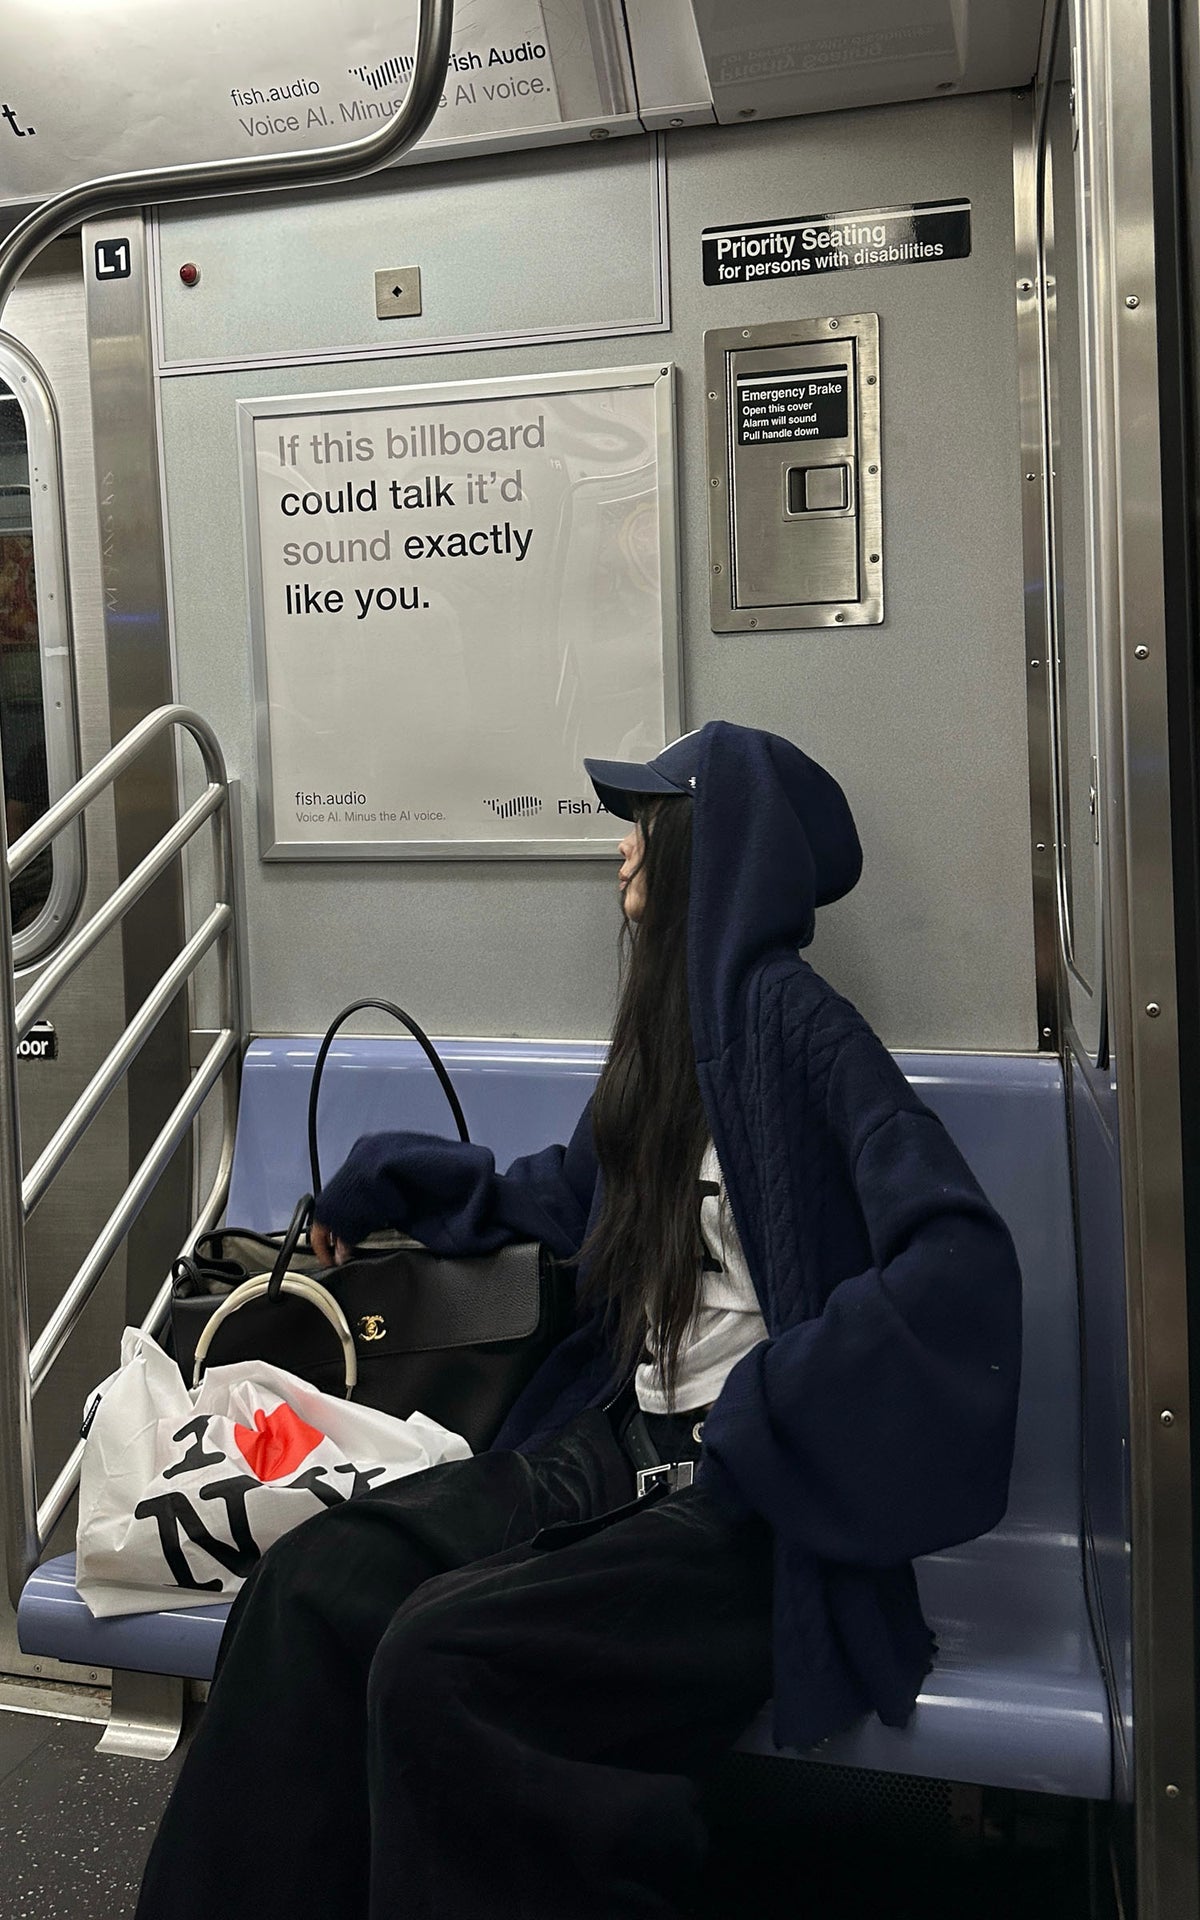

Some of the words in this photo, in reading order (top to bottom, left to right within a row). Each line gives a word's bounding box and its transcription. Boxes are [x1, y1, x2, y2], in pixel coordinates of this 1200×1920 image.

[448, 51, 482, 71] ish
[488, 41, 546, 67] Audio
[230, 78, 320, 106] fish.audio
[239, 115, 300, 137] Voice
[307, 106, 334, 128] AI.
[455, 83, 477, 106] AI
[482, 76, 551, 101] voice.
[717, 231, 797, 260] Priority
[801, 223, 886, 250] Seating
[98, 245, 128, 274] L1
[718, 264, 742, 280] for
[745, 256, 811, 281] persons
[814, 250, 849, 269] with
[854, 243, 944, 265] disabilities
[742, 387, 805, 402] Emergency
[808, 383, 842, 396] Brake
[742, 405, 767, 416] Open
[768, 403, 785, 413] this
[787, 402, 813, 412] cover
[742, 419, 769, 428] Alarm
[771, 416, 787, 425] will
[788, 413, 817, 424] sound
[278, 434, 299, 466] If
[310, 430, 375, 464] this
[386, 415, 545, 459] billboard
[743, 431, 760, 441] Pull
[762, 429, 792, 440] handle
[794, 427, 819, 436] down
[280, 480, 378, 516] could
[389, 475, 455, 510] talk
[466, 469, 523, 505] it’d
[282, 529, 391, 566] sound
[403, 522, 533, 561] exactly
[285, 584, 344, 615] like
[354, 586, 430, 619] you.
[295, 791, 367, 806] fish.audio
[558, 799, 592, 815] Fish
[296, 812, 325, 823] Voice
[327, 811, 341, 822] AI.
[344, 811, 377, 822] Minus
[379, 810, 397, 822] the
[399, 810, 411, 821] AI
[414, 810, 446, 821] voice.
[16, 1040, 49, 1056] oor
